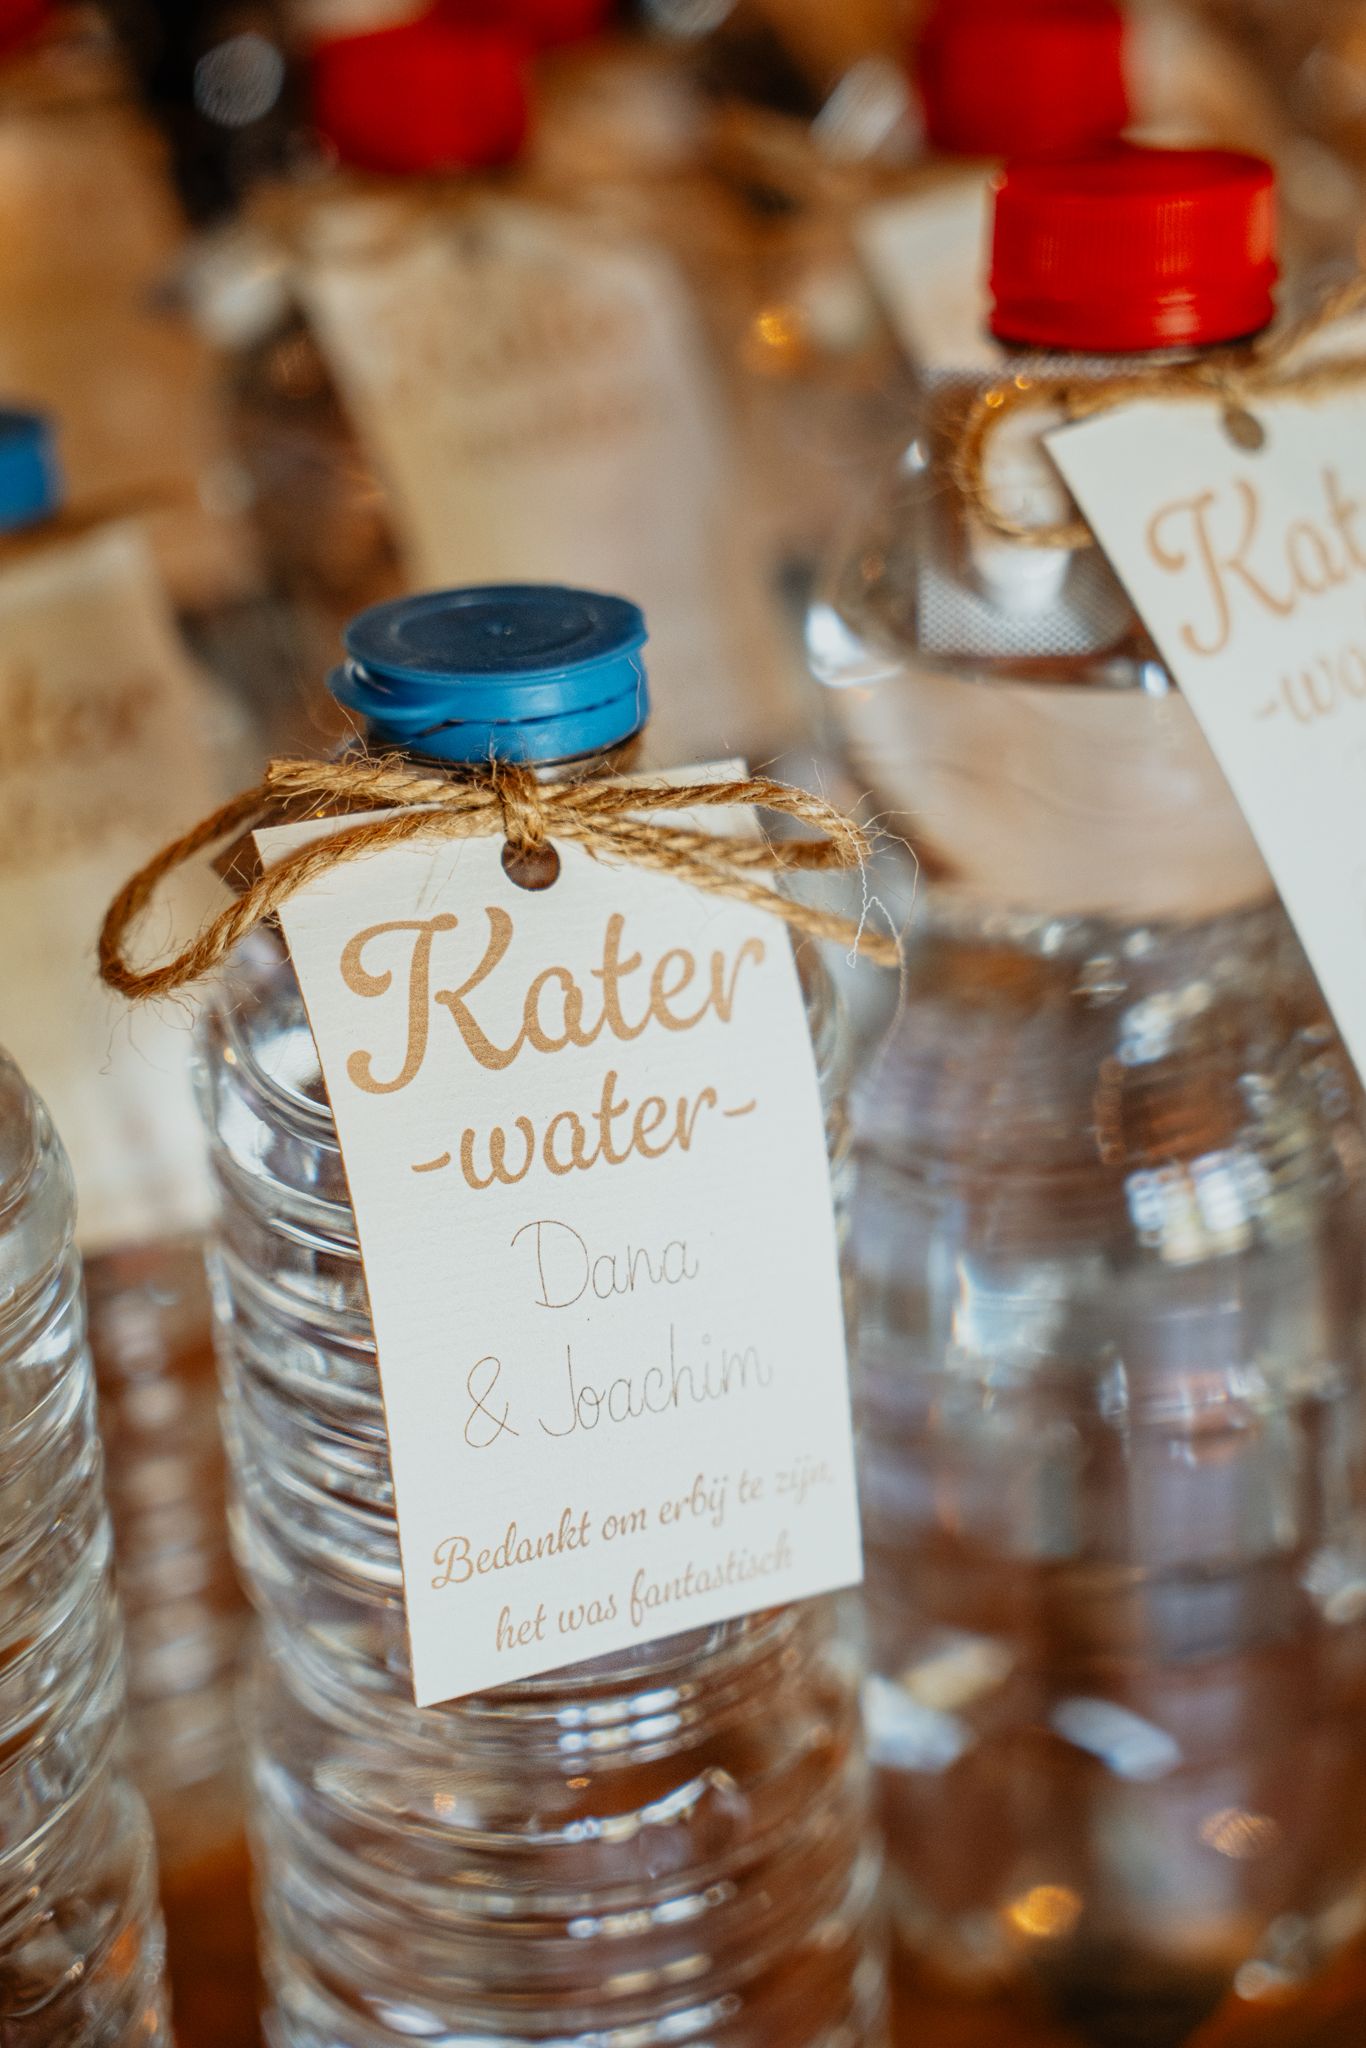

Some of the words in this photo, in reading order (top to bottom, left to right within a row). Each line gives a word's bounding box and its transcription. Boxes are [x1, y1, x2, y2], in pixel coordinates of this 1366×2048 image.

[340, 906, 766, 1095] Kater
[411, 1070, 757, 1190] -water-
[511, 1220, 699, 1309] Dana
[464, 1356, 520, 1448] &
[538, 1323, 774, 1437] Joachim
[431, 1507, 592, 1590] Bedankt
[601, 1504, 648, 1541] om
[659, 1472, 728, 1528] erbij
[738, 1469, 763, 1504] te
[496, 1605, 547, 1652] het
[558, 1593, 617, 1633] was
[629, 1529, 793, 1627] fantastisch
